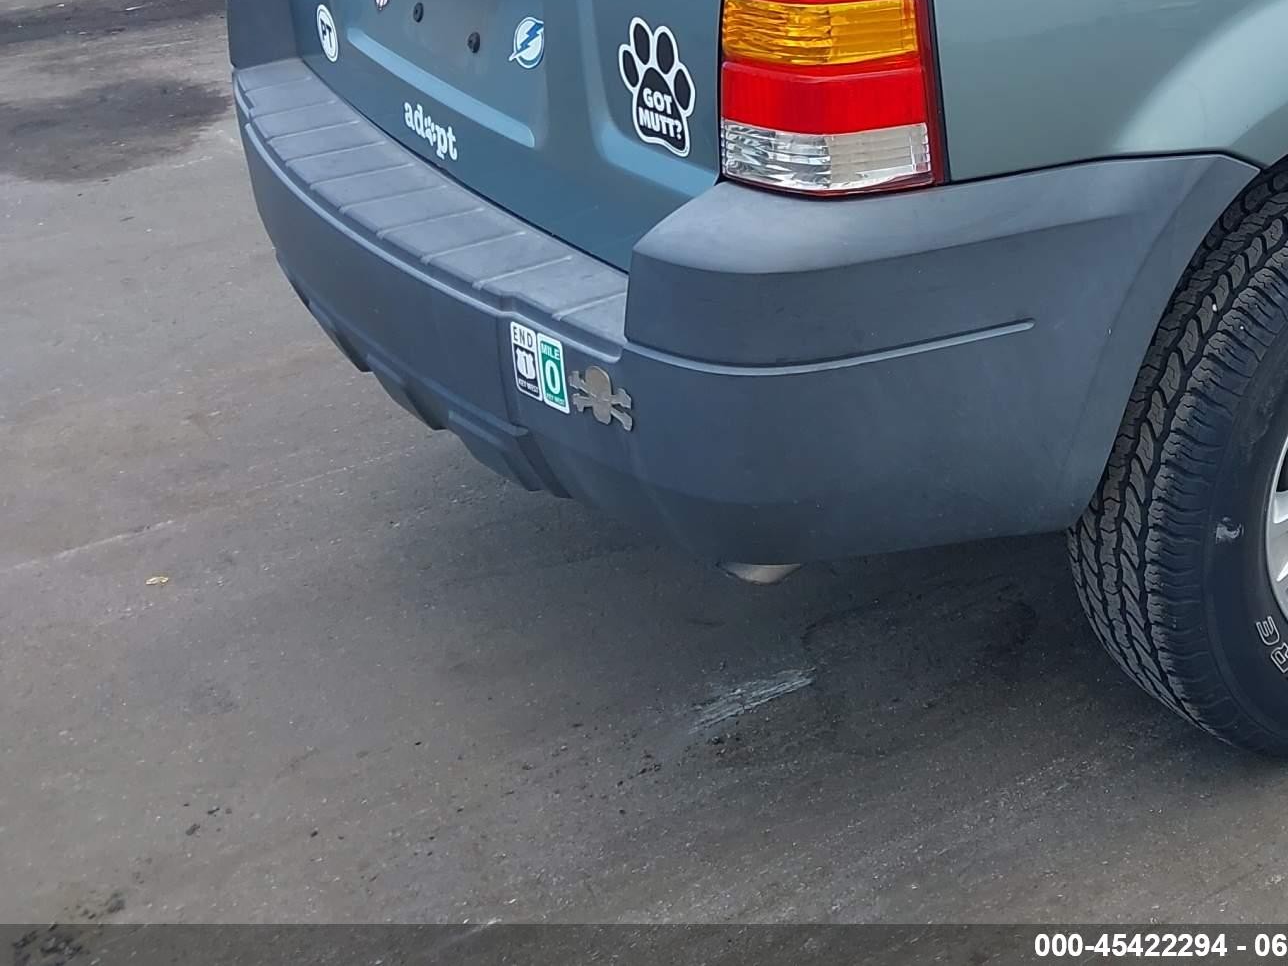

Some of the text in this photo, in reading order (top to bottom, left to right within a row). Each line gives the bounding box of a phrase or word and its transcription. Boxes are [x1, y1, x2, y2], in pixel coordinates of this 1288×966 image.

[320, 17, 332, 49] PT
[643, 87, 673, 115] GOT
[638, 106, 683, 140] MUTT?
[513, 326, 534, 348] END
[541, 342, 560, 360] MILE
[545, 359, 561, 395] 0
